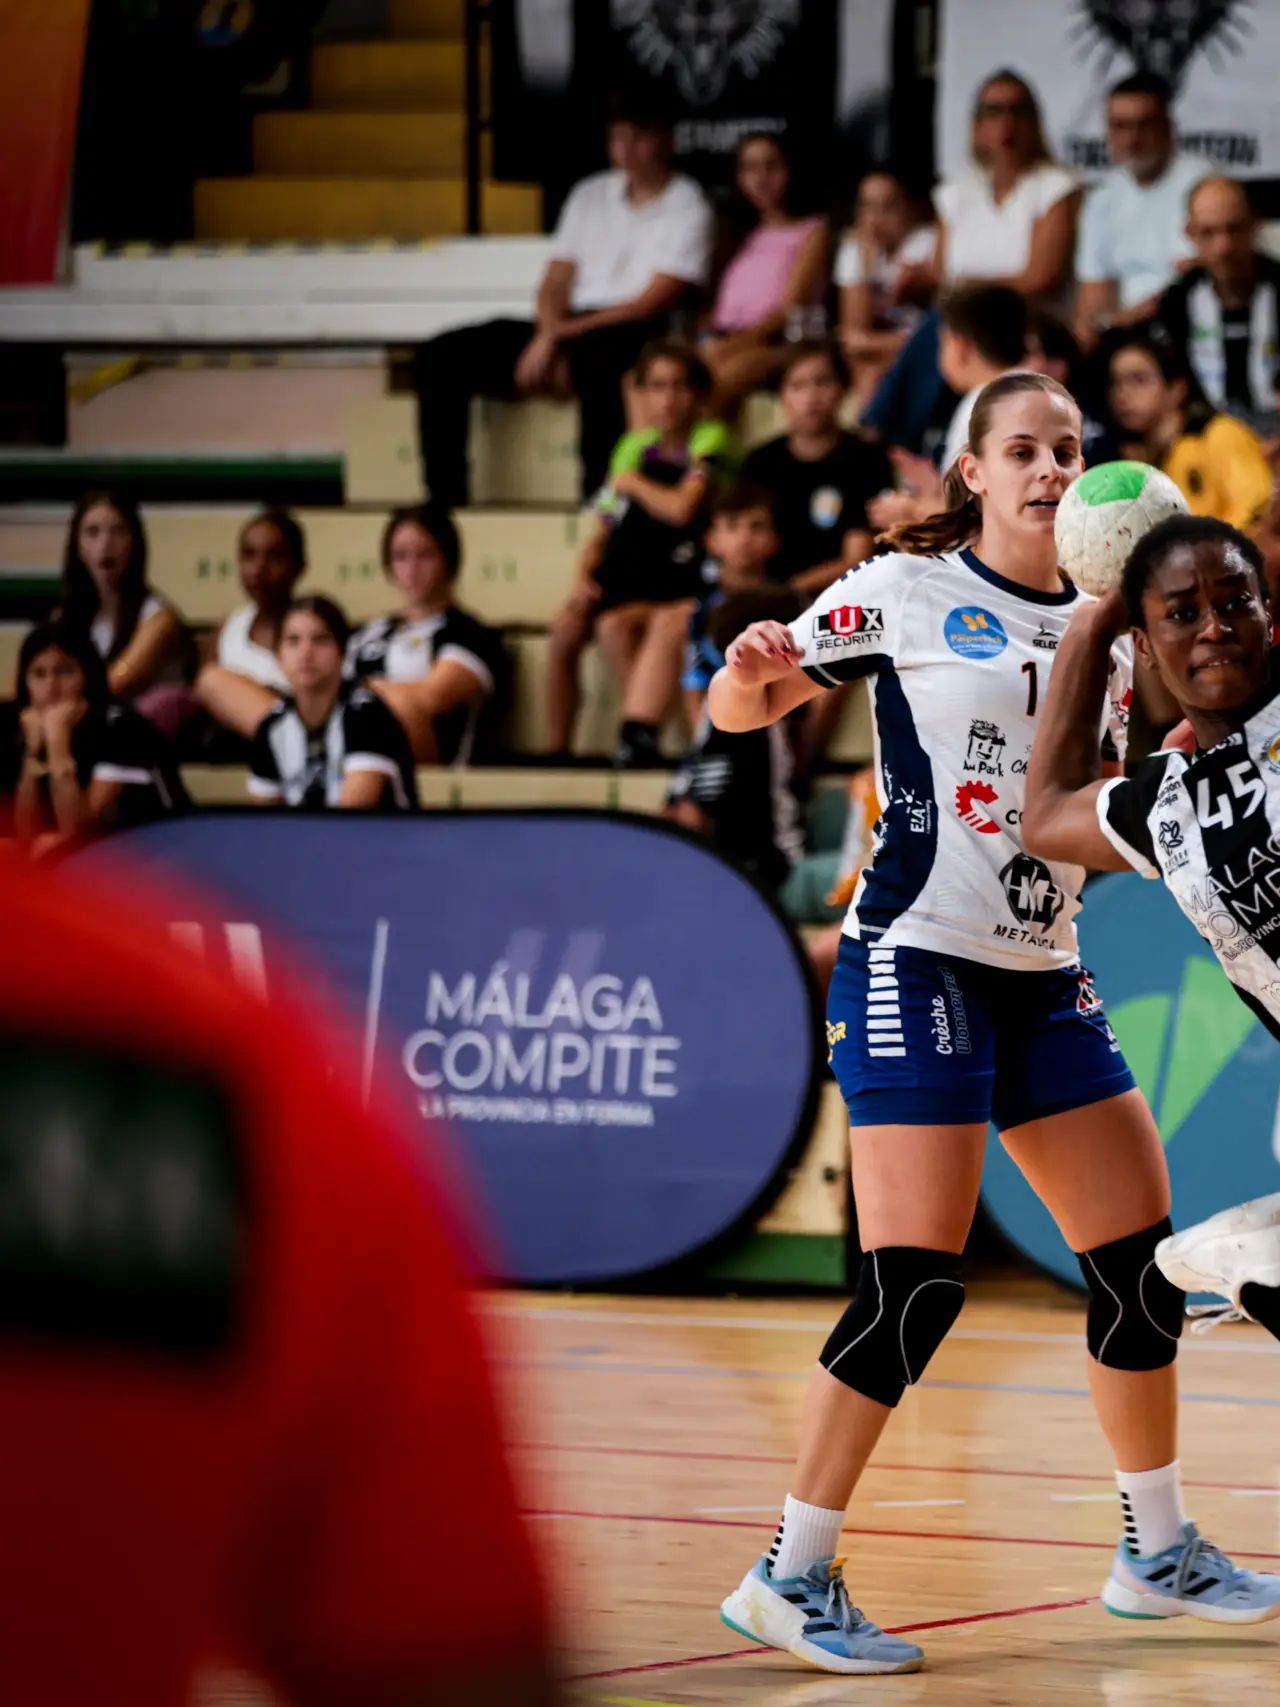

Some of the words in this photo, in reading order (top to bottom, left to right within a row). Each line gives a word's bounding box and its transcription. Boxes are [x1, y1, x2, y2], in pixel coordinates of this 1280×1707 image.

[813, 604, 884, 638] LUX
[816, 633, 883, 650] SECURITY
[1032, 638, 1059, 650] SELEC
[978, 762, 1004, 778] Park
[1197, 760, 1266, 830] 45
[910, 808, 926, 833] ELA
[426, 960, 663, 1031] MÁLAGA
[931, 995, 953, 1054] Crèche
[403, 1028, 682, 1098] COMPITE
